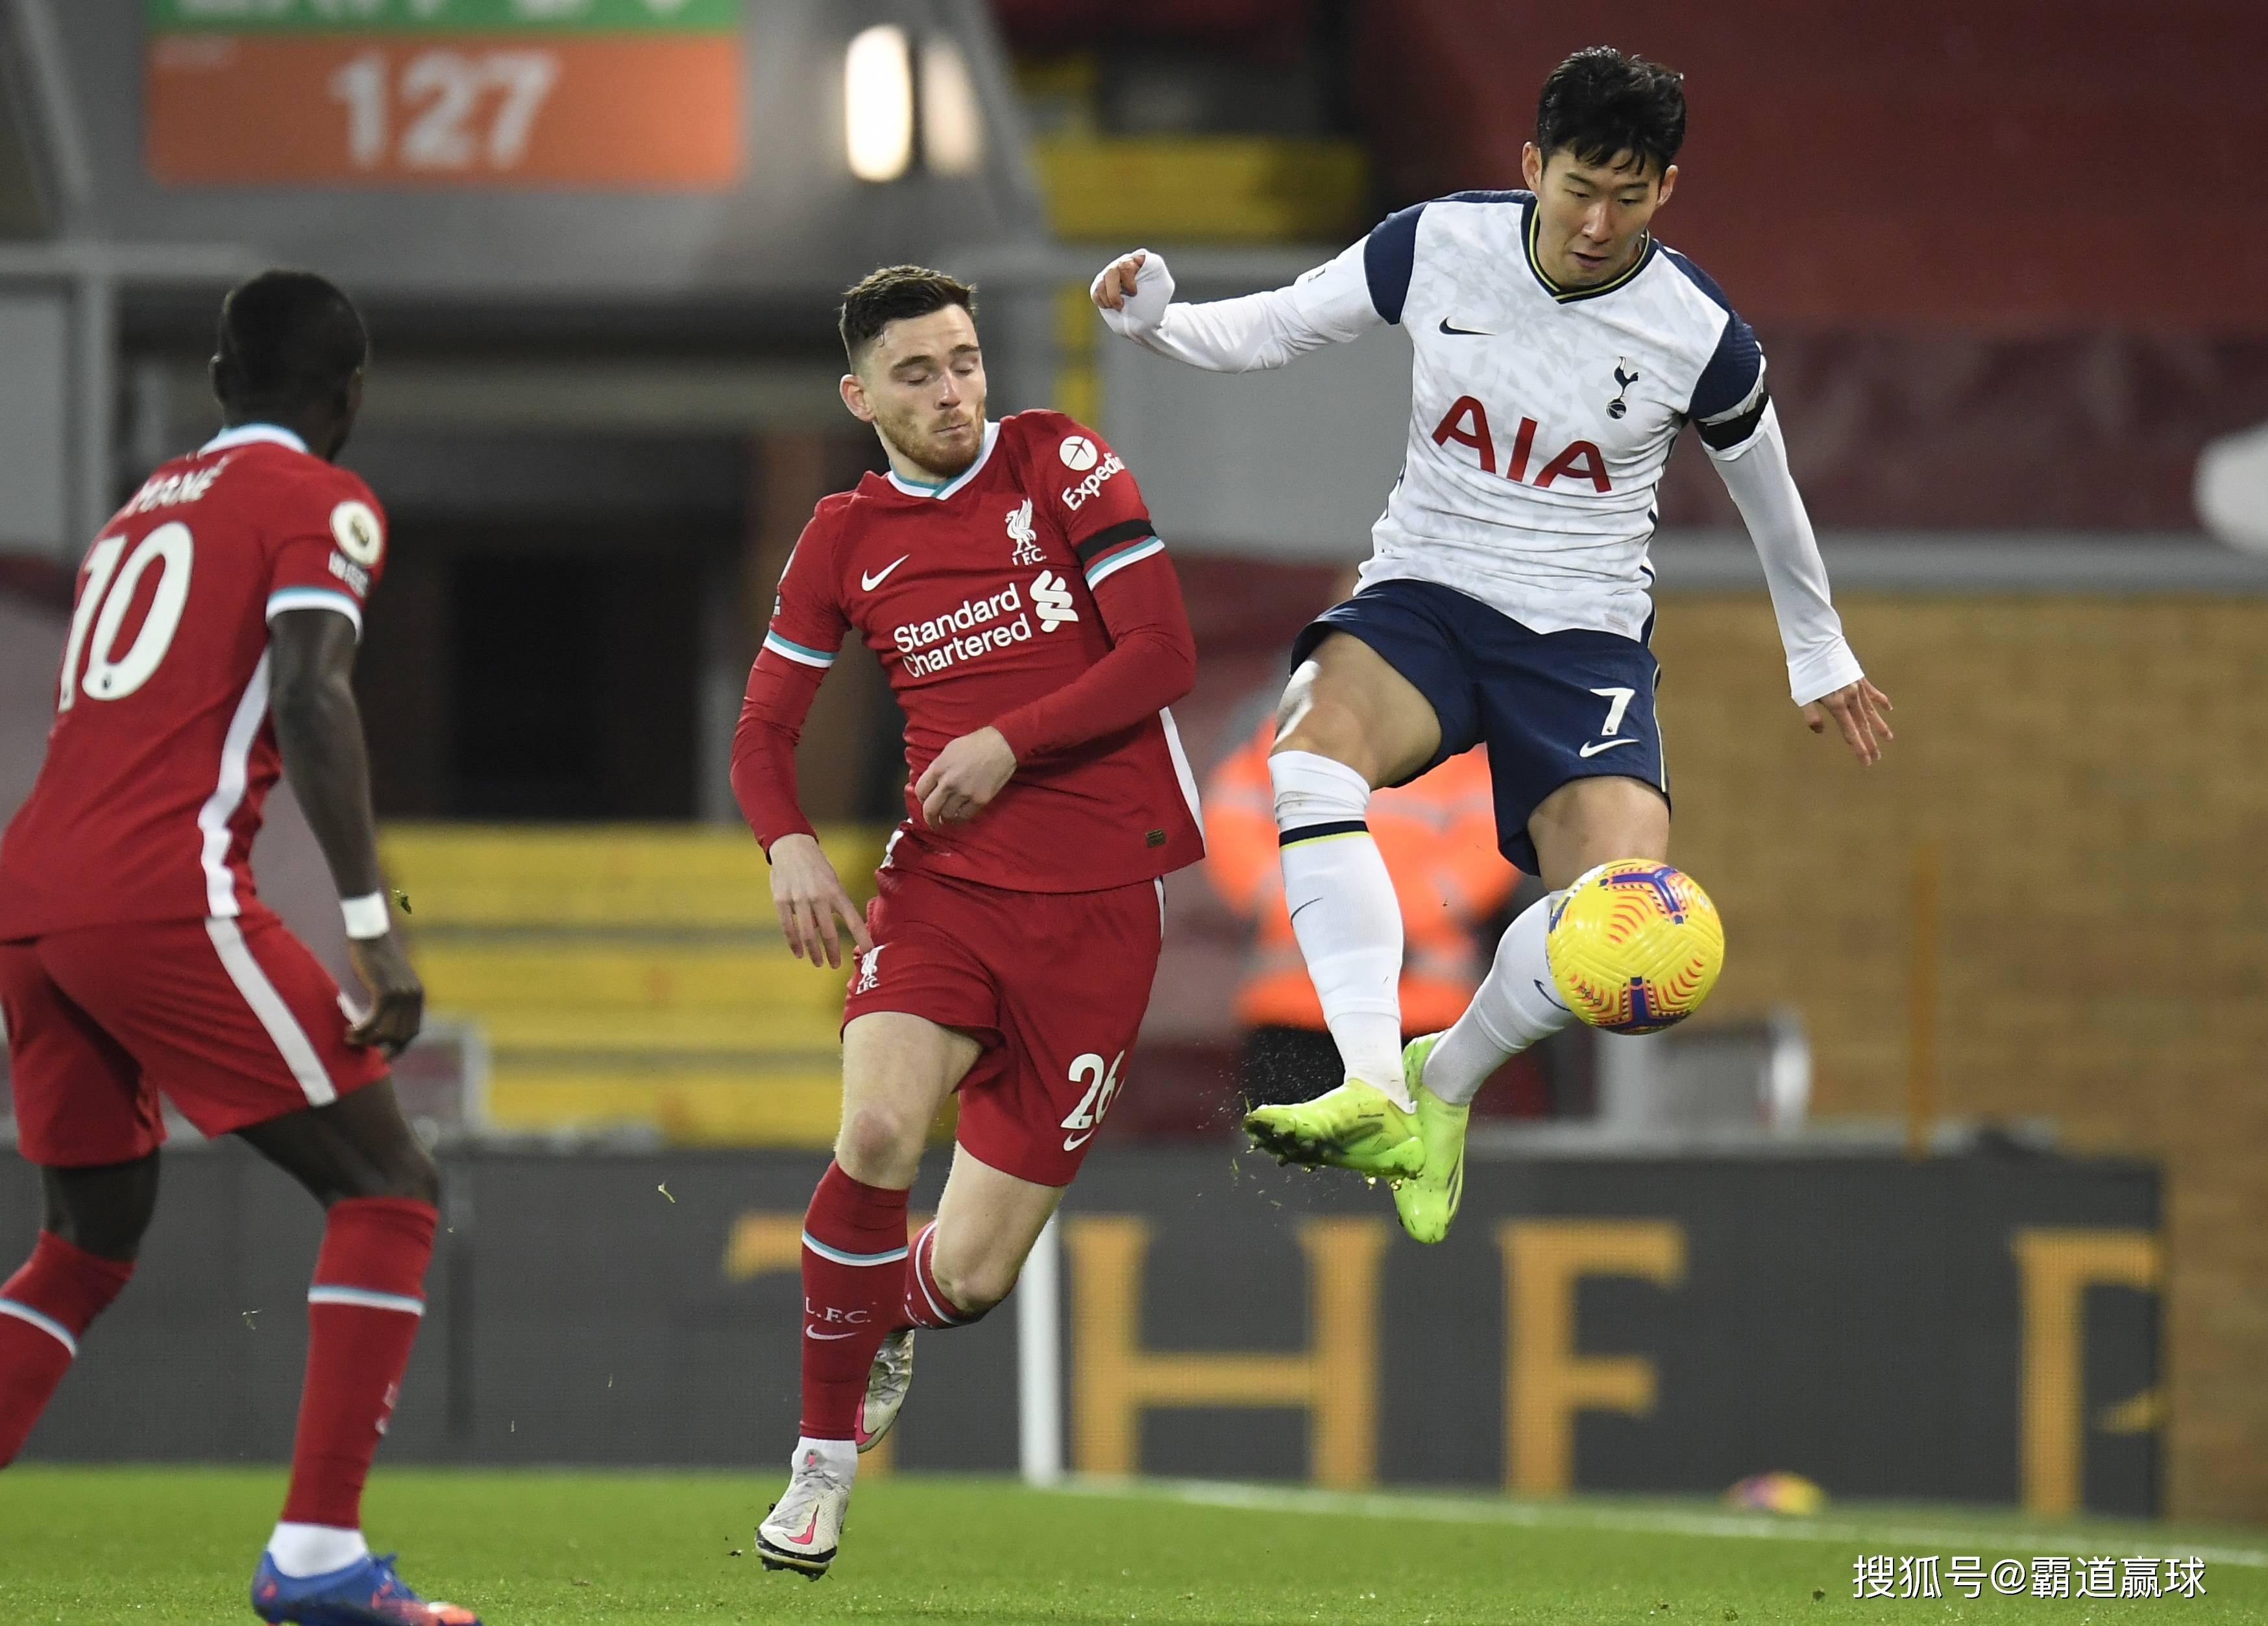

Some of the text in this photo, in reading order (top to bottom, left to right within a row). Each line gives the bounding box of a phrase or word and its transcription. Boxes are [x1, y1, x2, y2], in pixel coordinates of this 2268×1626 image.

[327, 47, 561, 171] 127
[1432, 395, 1612, 494] AIA
[58, 521, 193, 712] 10
[894, 582, 1021, 653] Standard
[903, 613, 1032, 678] Chartered
[1589, 687, 1635, 736] 7
[1060, 1049, 1126, 1130] 26
